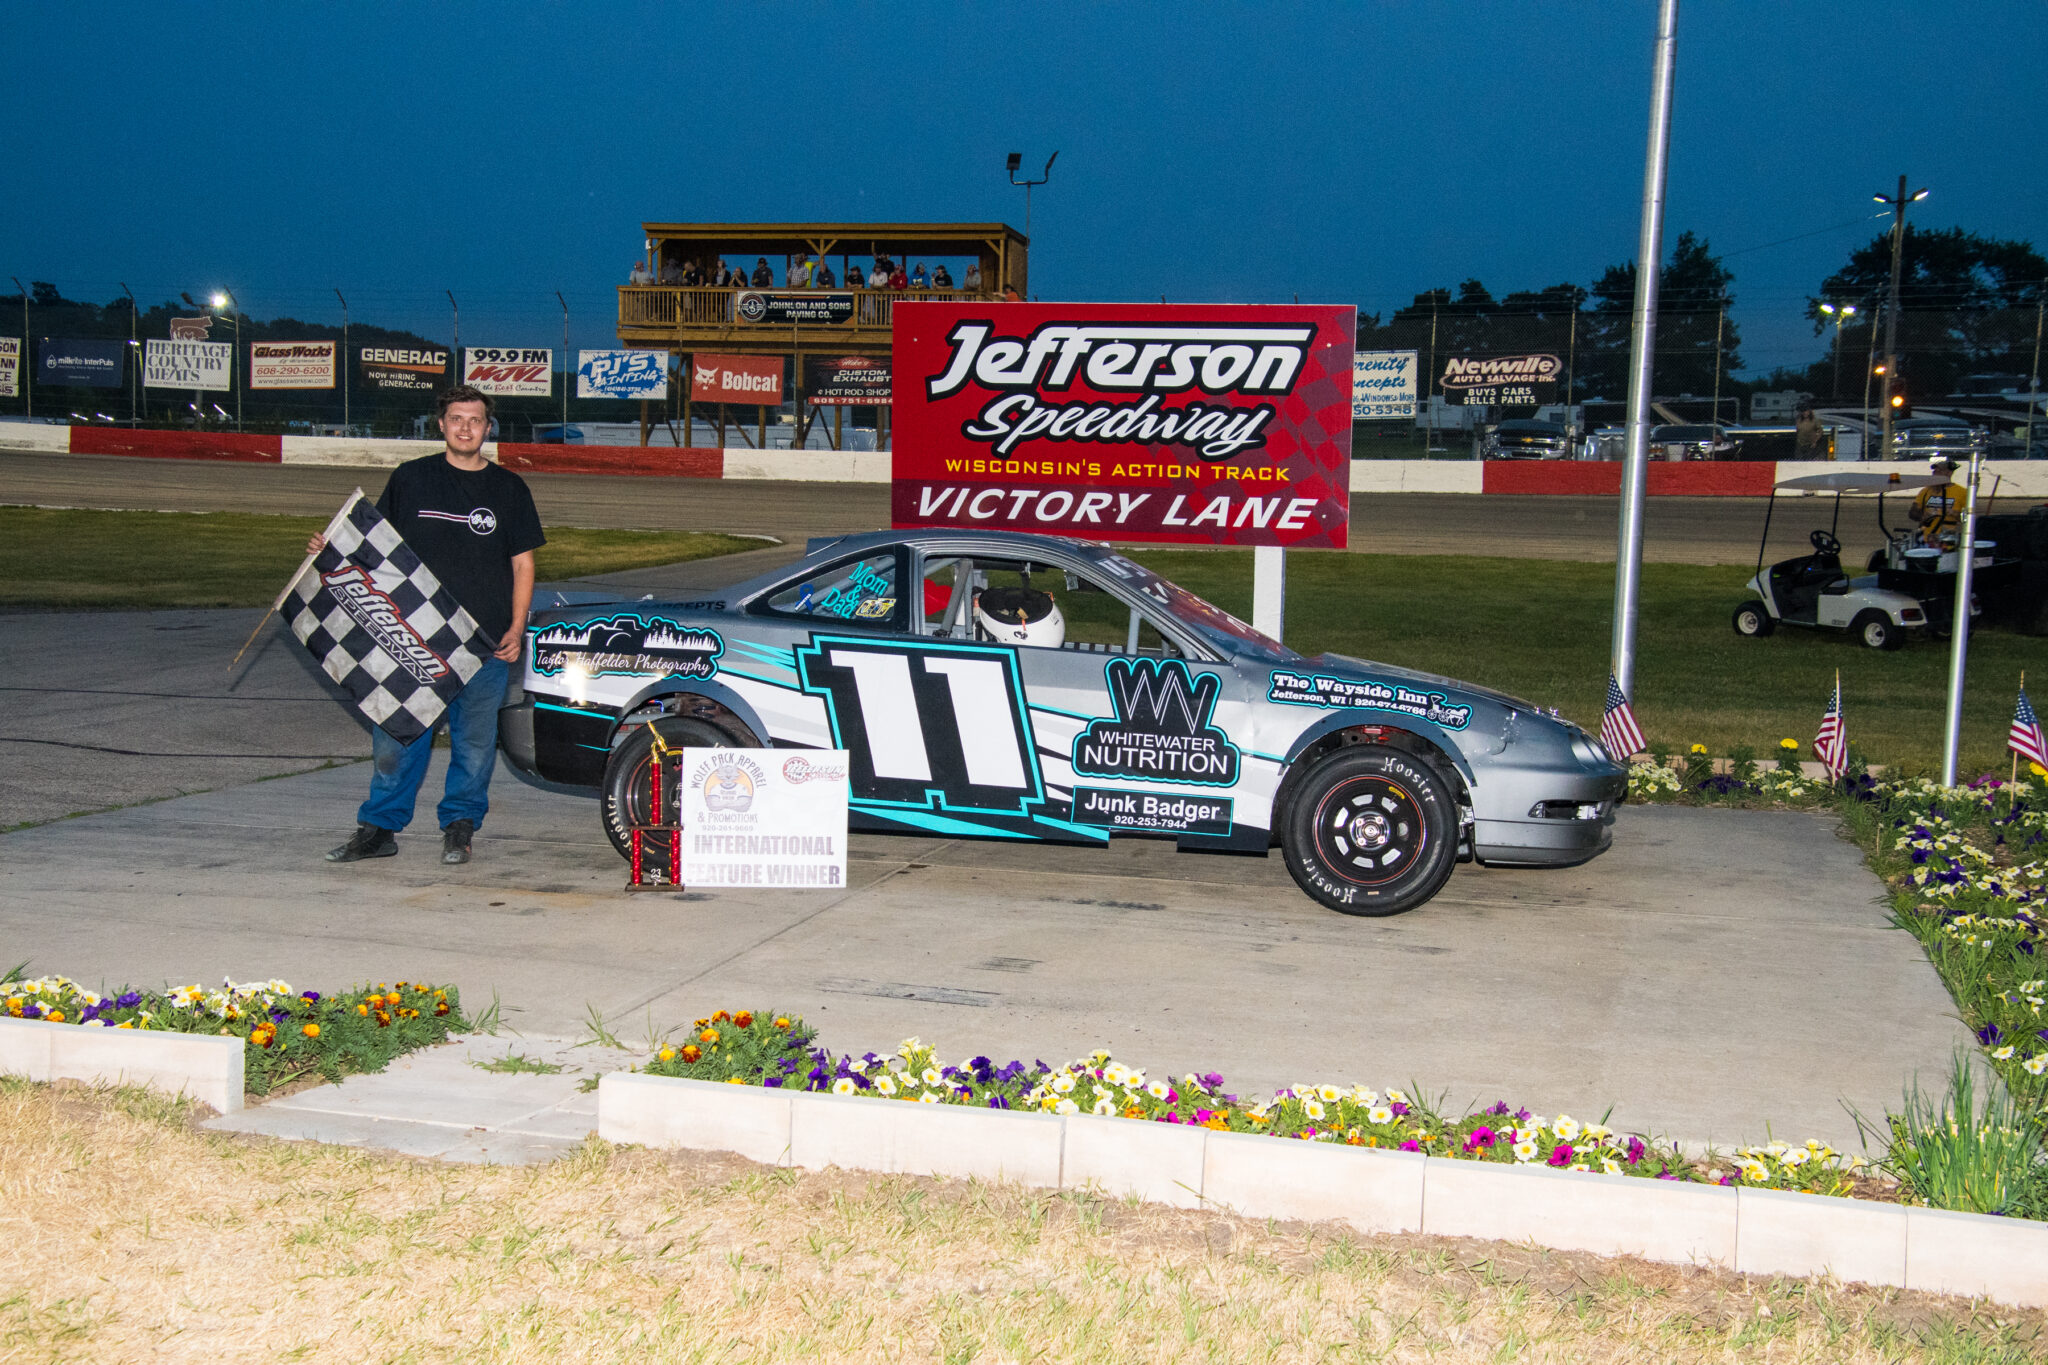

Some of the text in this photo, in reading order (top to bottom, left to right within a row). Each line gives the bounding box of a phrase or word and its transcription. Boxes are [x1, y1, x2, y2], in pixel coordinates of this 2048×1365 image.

[786, 310, 816, 318] PAVING
[809, 302, 826, 310] AND
[828, 302, 851, 310] SONS
[148, 342, 230, 358] HERITAGE
[254, 345, 332, 358] GlassWorks
[361, 348, 447, 365] GENERAC
[474, 349, 548, 363] 99.9 FM
[931, 325, 1312, 394] Jefferson
[148, 355, 222, 370] COUNTRY
[256, 366, 330, 375] 608-290-6200
[590, 354, 649, 378] PJ'S
[1445, 358, 1554, 375] Newville
[148, 366, 200, 381] MEATS
[390, 373, 416, 381] HIRING
[593, 369, 658, 388] PAINTING
[722, 370, 778, 392] Bobcat
[1452, 375, 1482, 383] AUTO
[379, 380, 433, 389] GENERAC.COM
[824, 388, 843, 396] HOT
[844, 388, 864, 396] ROD
[866, 388, 892, 396] SHOP
[1468, 387, 1532, 396] BUYS CARS
[1463, 395, 1536, 405] SELLS PARTS
[966, 393, 1270, 457] Speedway
[945, 458, 1290, 481] WISCONSIN'S ACTION TRACK
[918, 486, 1319, 529] VICTORY LANE
[848, 561, 888, 596] Mom
[821, 587, 859, 619] Dad
[325, 568, 447, 676] Jefferson
[333, 587, 431, 681] SPEEDWAY
[634, 653, 710, 676] Photography
[1271, 690, 1326, 704] Jefferson,
[1330, 695, 1346, 705] WI
[1274, 674, 1428, 705] The Wayside Inn
[830, 650, 1027, 789] 11
[1099, 730, 1215, 751] WHITEWATER
[1084, 745, 1228, 774] NUTRITION
[711, 752, 735, 767] PACK
[737, 755, 767, 789] APPAREL
[1381, 756, 1435, 802] Hoosier
[708, 812, 758, 823] PROMOTIONS
[1085, 793, 1220, 823] Junk Badger
[1114, 815, 1188, 829] 920-253-7944
[694, 835, 835, 855] INTERNATIONAL
[687, 863, 840, 885] FEATURE WINNER
[1302, 858, 1357, 904] Hoosier
